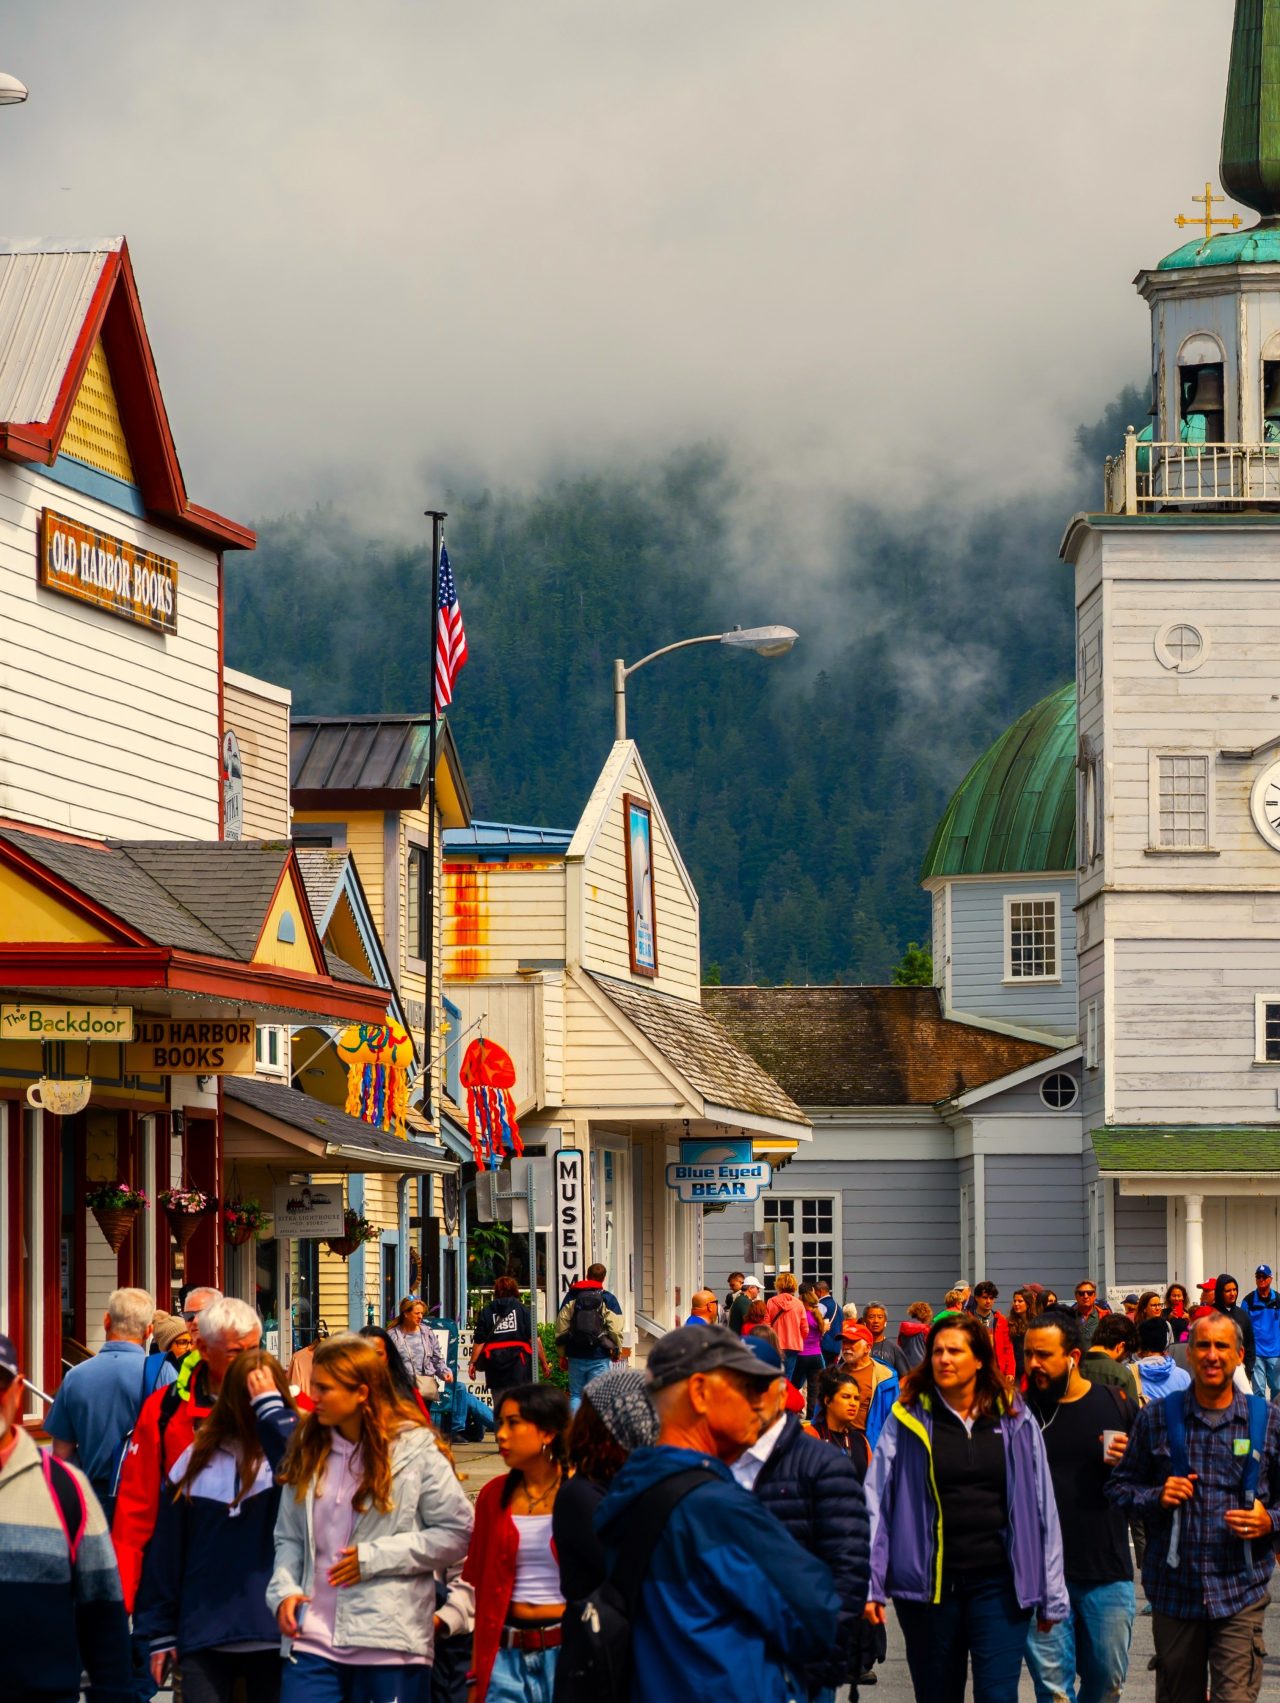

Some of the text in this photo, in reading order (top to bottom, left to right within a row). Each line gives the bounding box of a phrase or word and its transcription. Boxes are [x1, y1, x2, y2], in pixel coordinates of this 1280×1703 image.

[52, 529, 172, 615] OLD HARBOR BOOKS
[4, 1011, 126, 1033] The Backdoor
[170, 1023, 251, 1043] HARBOR
[154, 1047, 225, 1067] BOOKS
[675, 1165, 762, 1180] Blue Eyed
[691, 1182, 746, 1196] BEAR
[559, 1160, 579, 1293] MUSEUM
